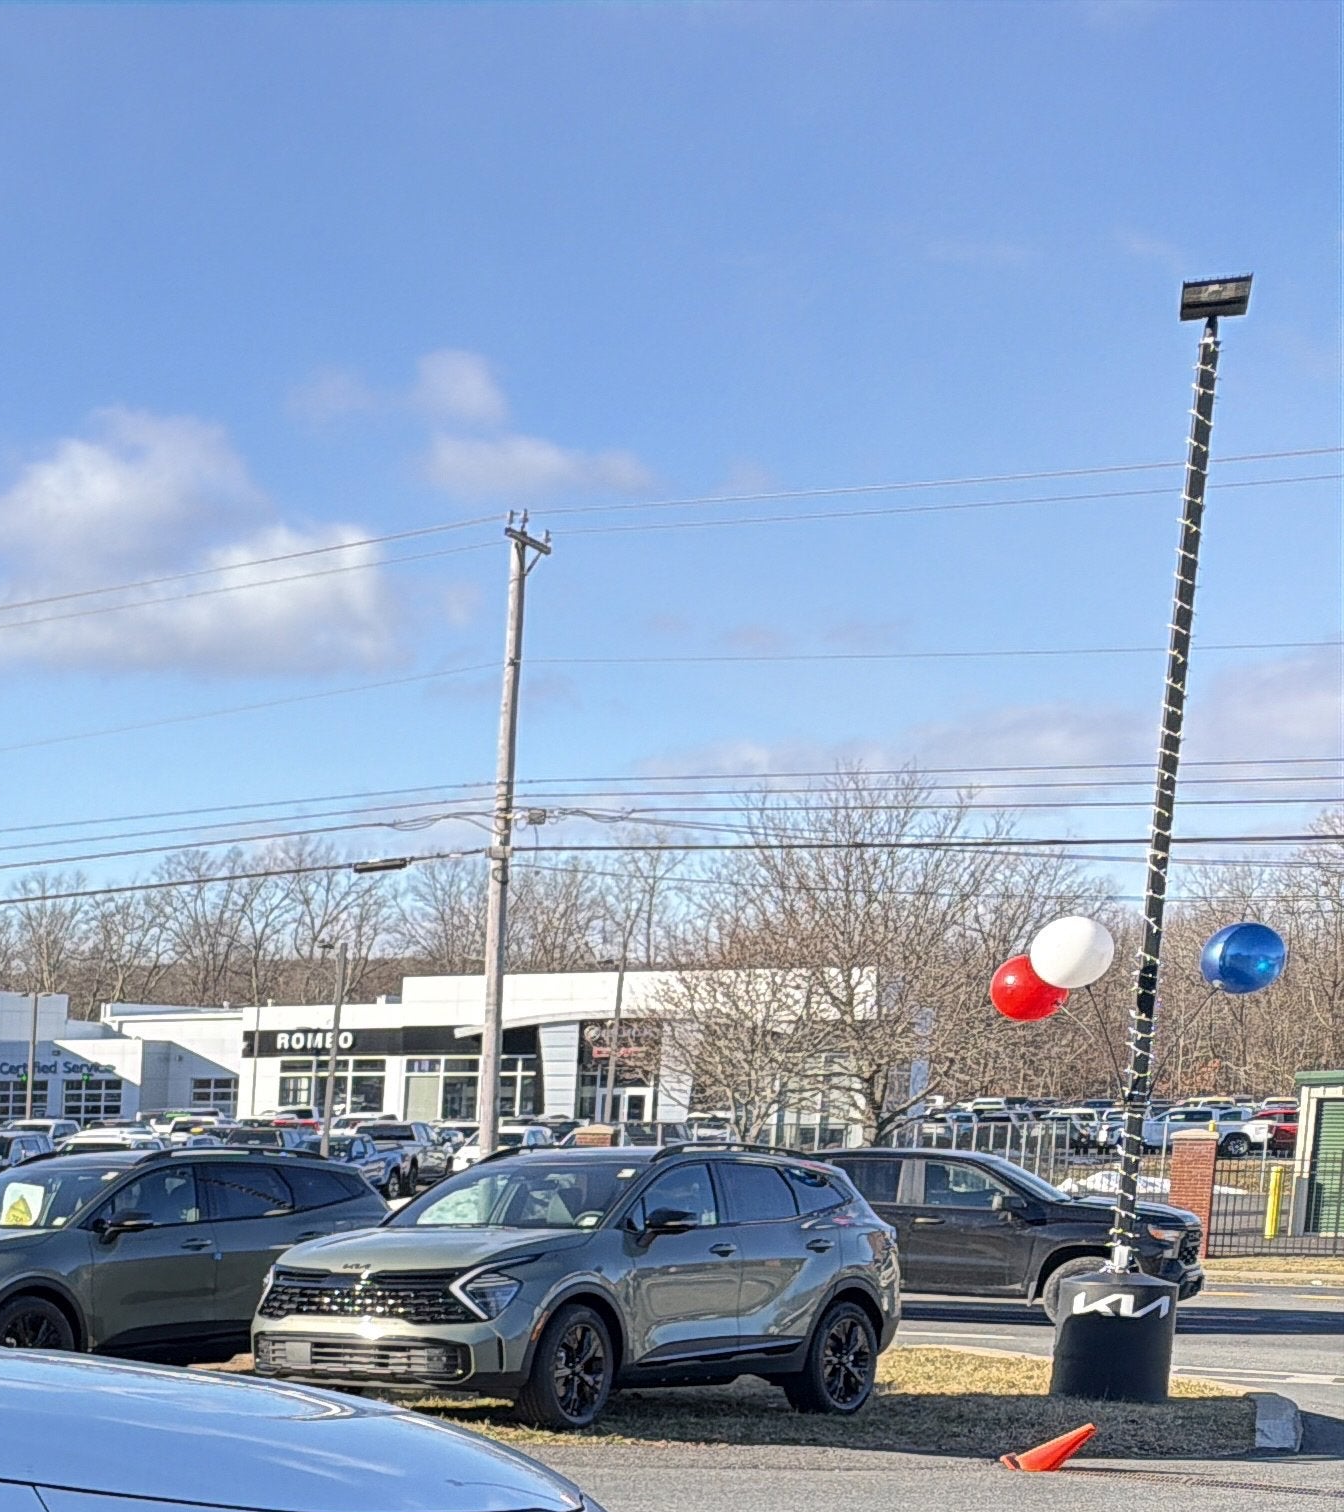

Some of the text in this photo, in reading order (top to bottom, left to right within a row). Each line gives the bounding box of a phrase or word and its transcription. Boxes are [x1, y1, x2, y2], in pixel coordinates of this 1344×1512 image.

[276, 1031, 354, 1050] ROMEO
[0, 1061, 116, 1075] Certfied Service
[1072, 1291, 1171, 1319] KIA
